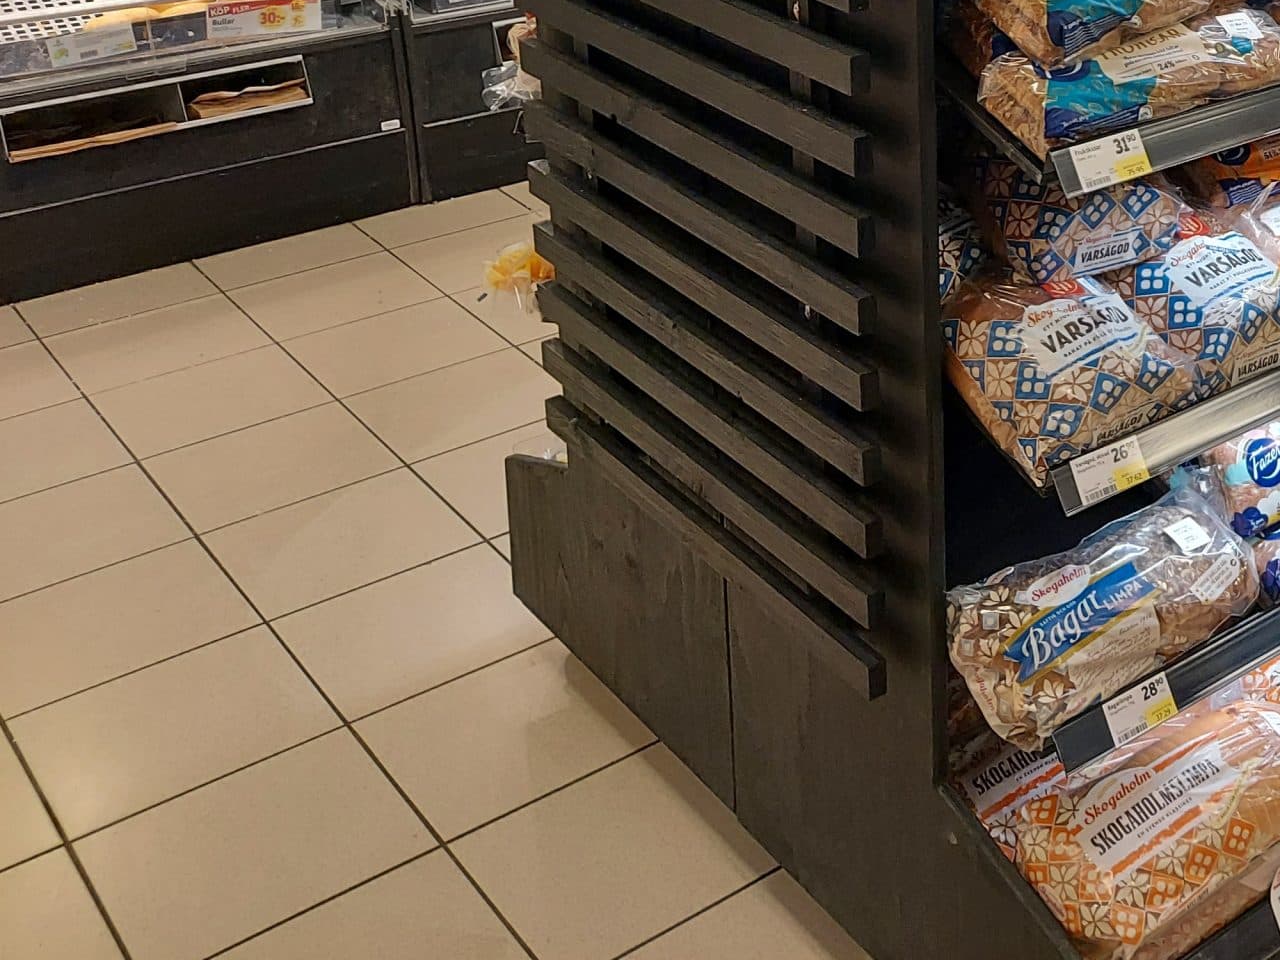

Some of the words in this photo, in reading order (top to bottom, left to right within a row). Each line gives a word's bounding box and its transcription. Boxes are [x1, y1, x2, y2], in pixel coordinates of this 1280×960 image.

[1080, 242, 1130, 263] VARSÅGOD
[1237, 352, 1279, 378] VARSÅGOD
[1032, 567, 1088, 602] Skogaholm
[1021, 589, 1104, 671] Bagar
[1102, 580, 1143, 611] LIMPA
[1083, 767, 1153, 826] Skogaholm
[1089, 758, 1221, 857] SKOGAHOLMSLIMPA
